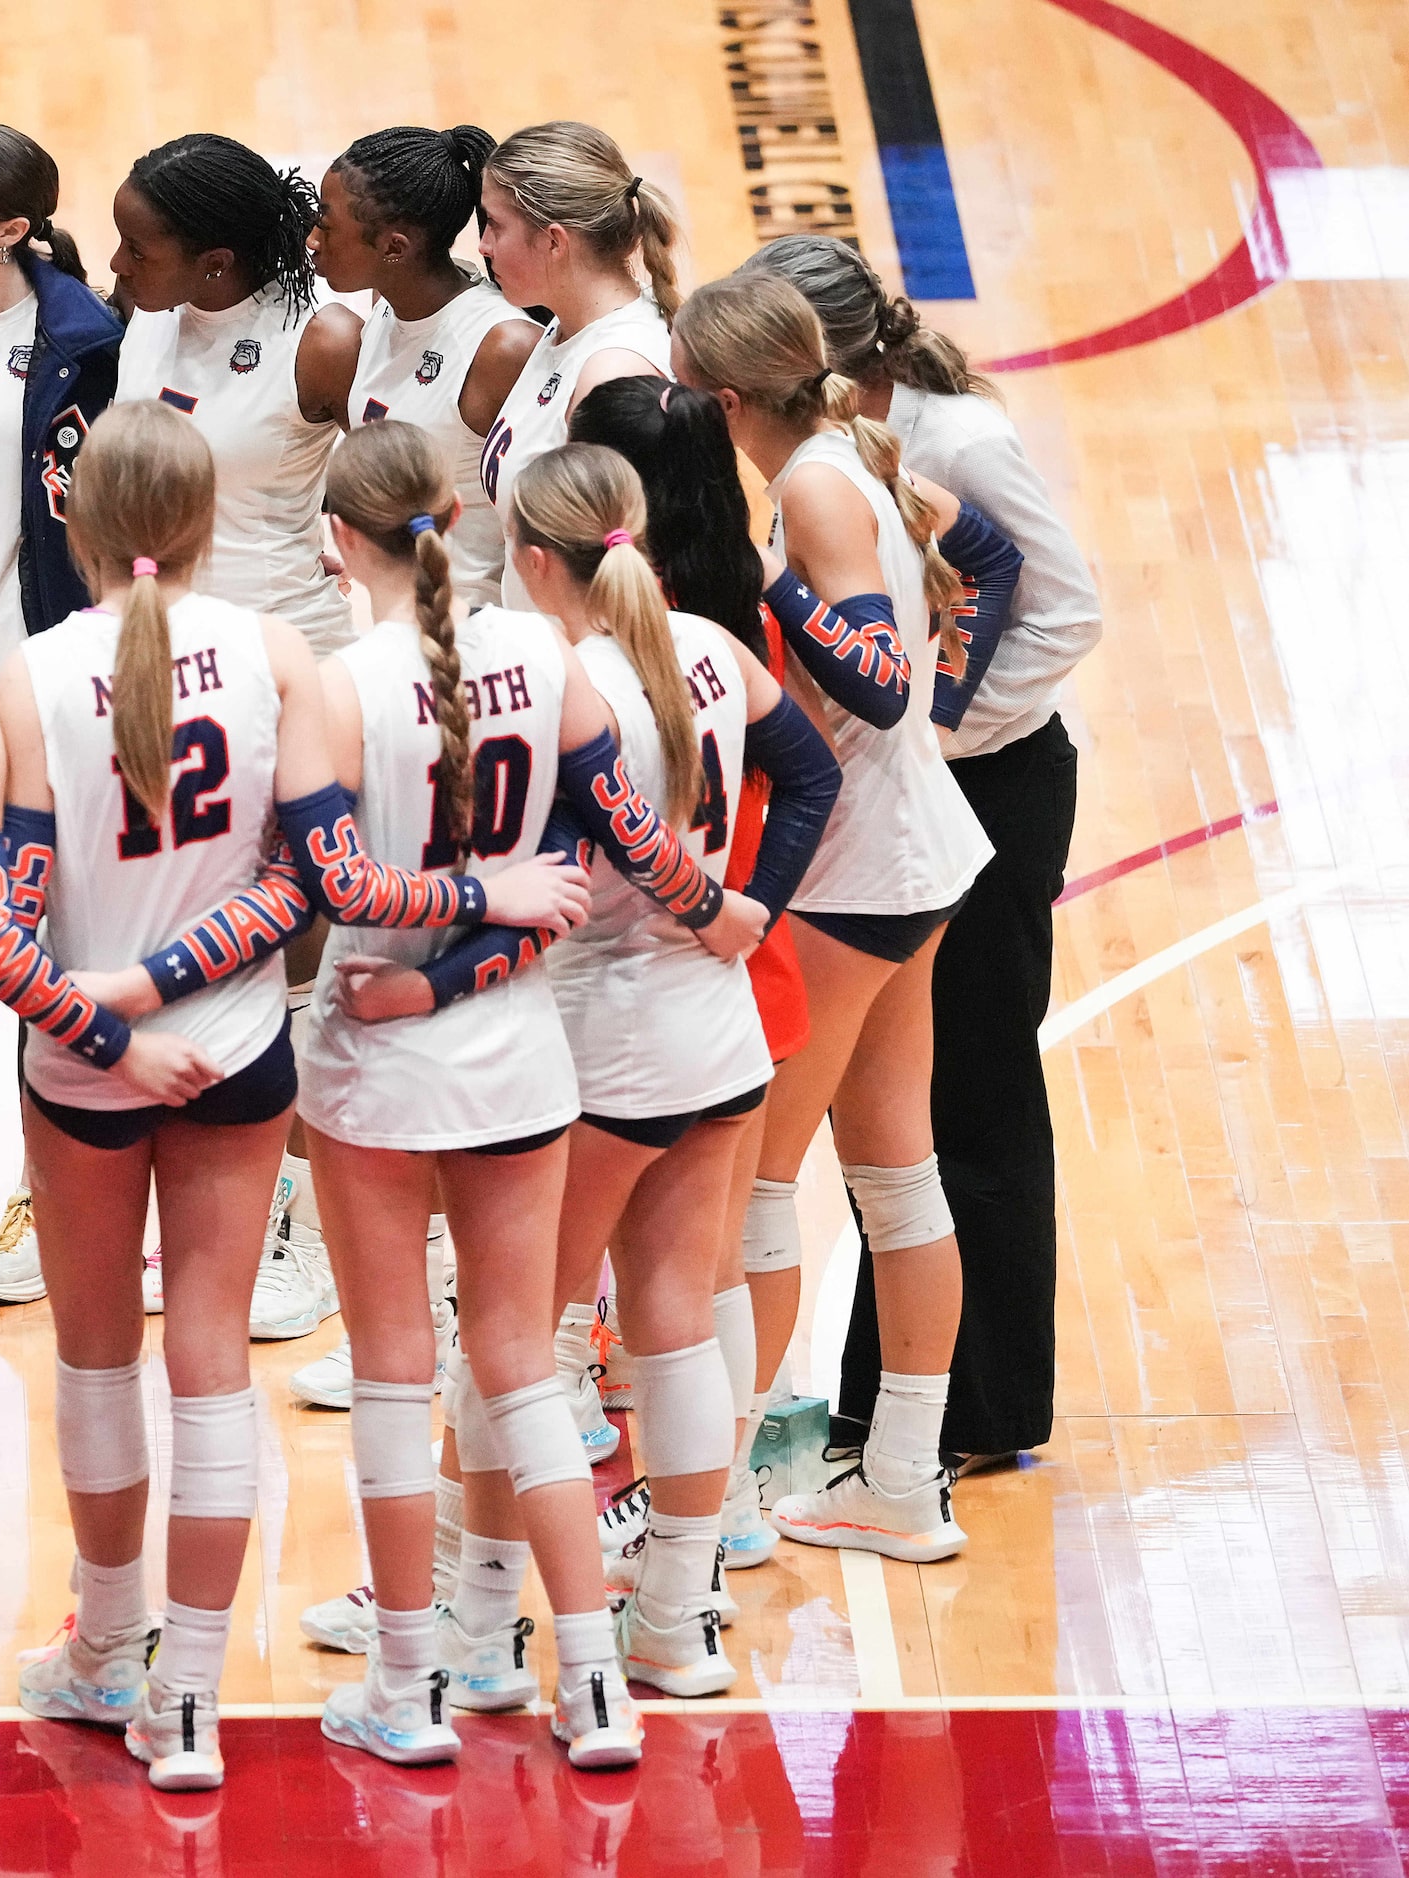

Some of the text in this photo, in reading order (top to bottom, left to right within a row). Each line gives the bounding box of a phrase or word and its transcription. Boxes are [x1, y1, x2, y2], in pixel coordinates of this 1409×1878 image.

[90, 648, 224, 718] NTH
[412, 664, 533, 725] NRTH
[111, 715, 232, 863] 12
[420, 733, 533, 871] 10
[181, 866, 311, 984] DAW
